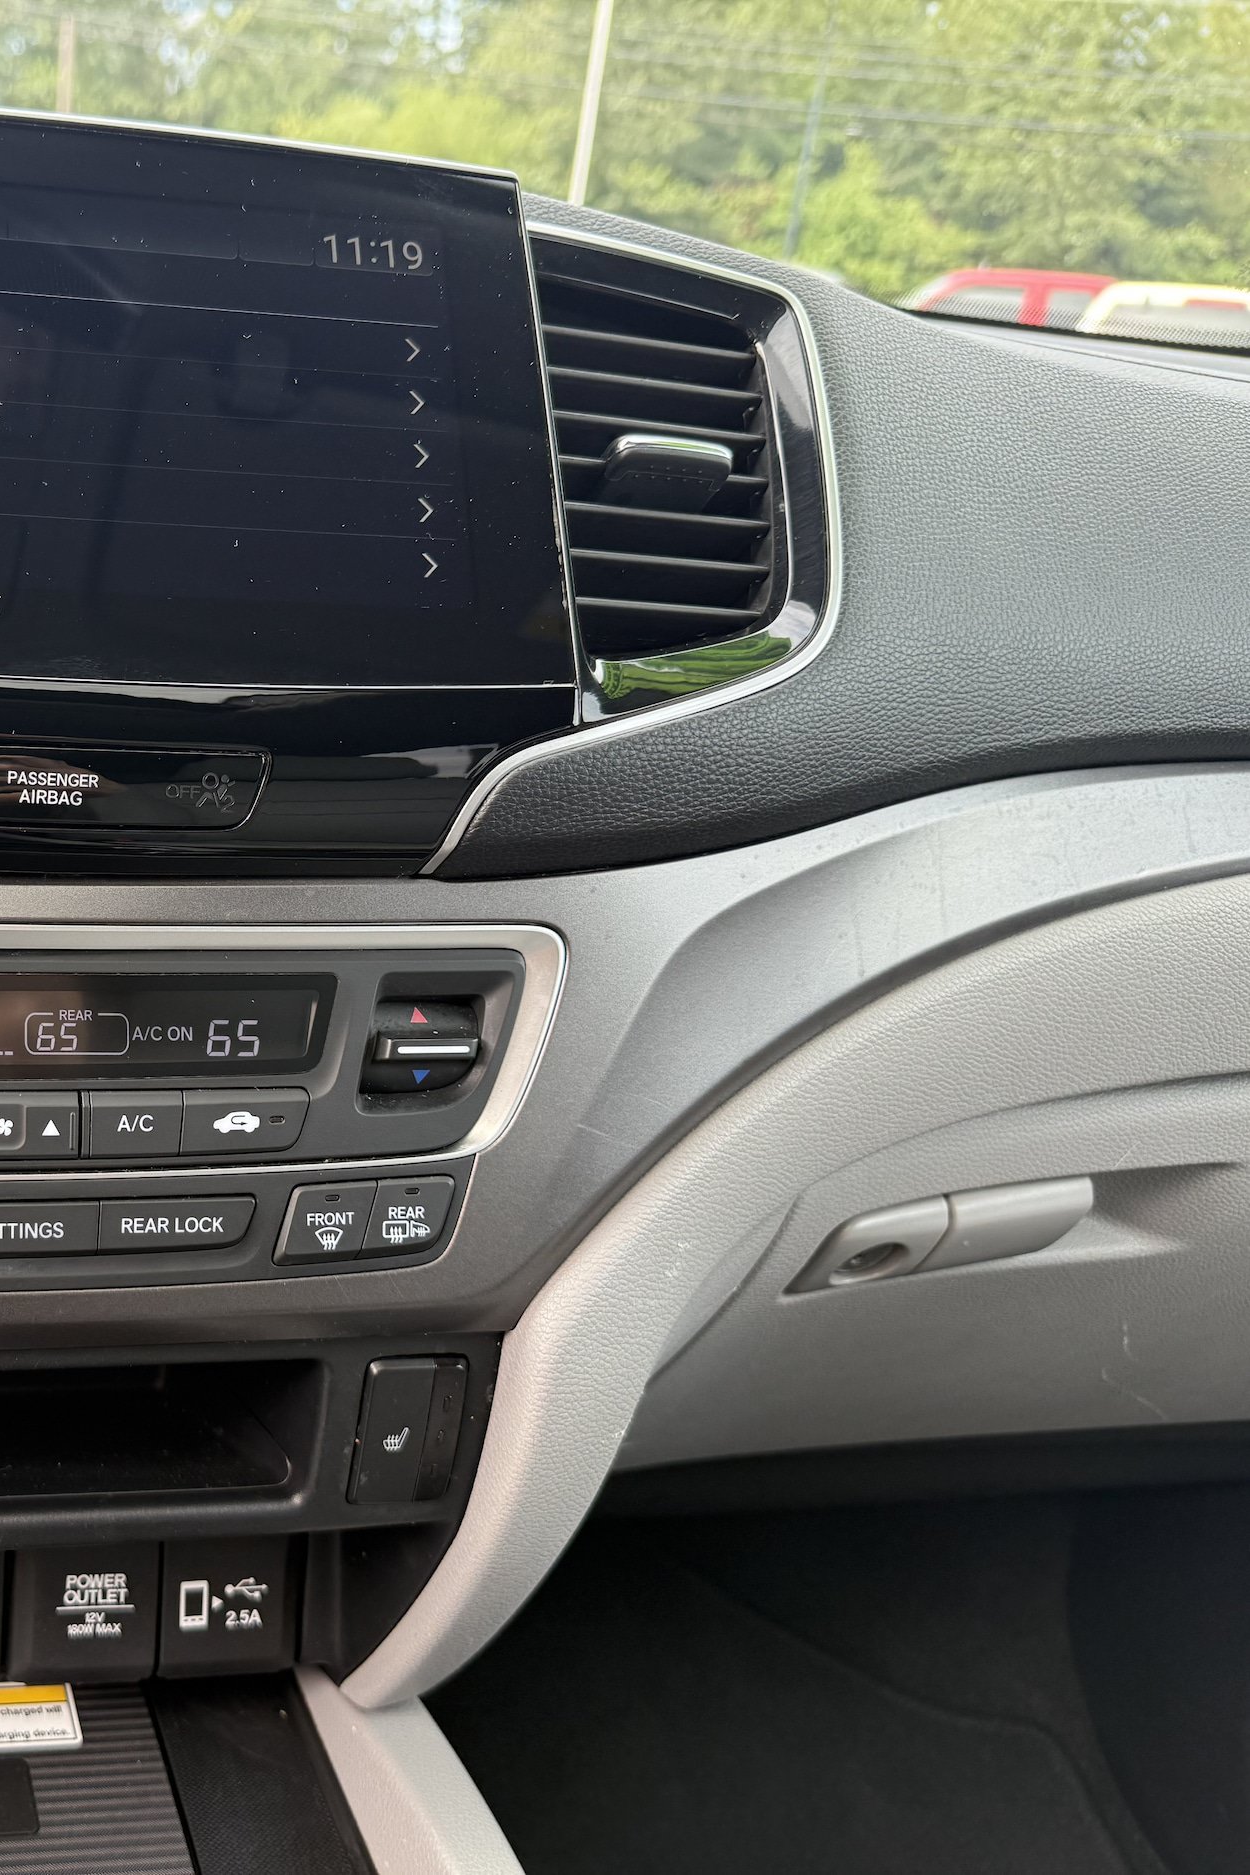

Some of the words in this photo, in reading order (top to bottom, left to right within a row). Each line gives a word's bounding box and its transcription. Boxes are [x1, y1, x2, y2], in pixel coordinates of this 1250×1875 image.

[323, 234, 423, 270] 11:19
[7, 770, 100, 788] PASSENGER
[18, 788, 83, 806] AIRBAG
[165, 784, 202, 799] OFF
[58, 1009, 93, 1021] REAR
[36, 1022, 78, 1051] 65
[132, 1026, 163, 1041] A/C
[167, 1026, 193, 1041] ON
[206, 1019, 260, 1057] 65
[117, 1115, 154, 1132] A/C
[306, 1211, 354, 1226] FRONT
[388, 1206, 425, 1219] REAR
[121, 1217, 169, 1234] REAR
[174, 1216, 224, 1233] LOCK
[65, 1573, 127, 1589] POWER
[63, 1588, 128, 1605] OUTLET
[85, 1612, 105, 1624] 12V
[225, 1608, 263, 1627] 2.5A
[96, 1622, 122, 1636] MAX
[0, 1705, 44, 1717] charged
[33, 1726, 71, 1738] device.
